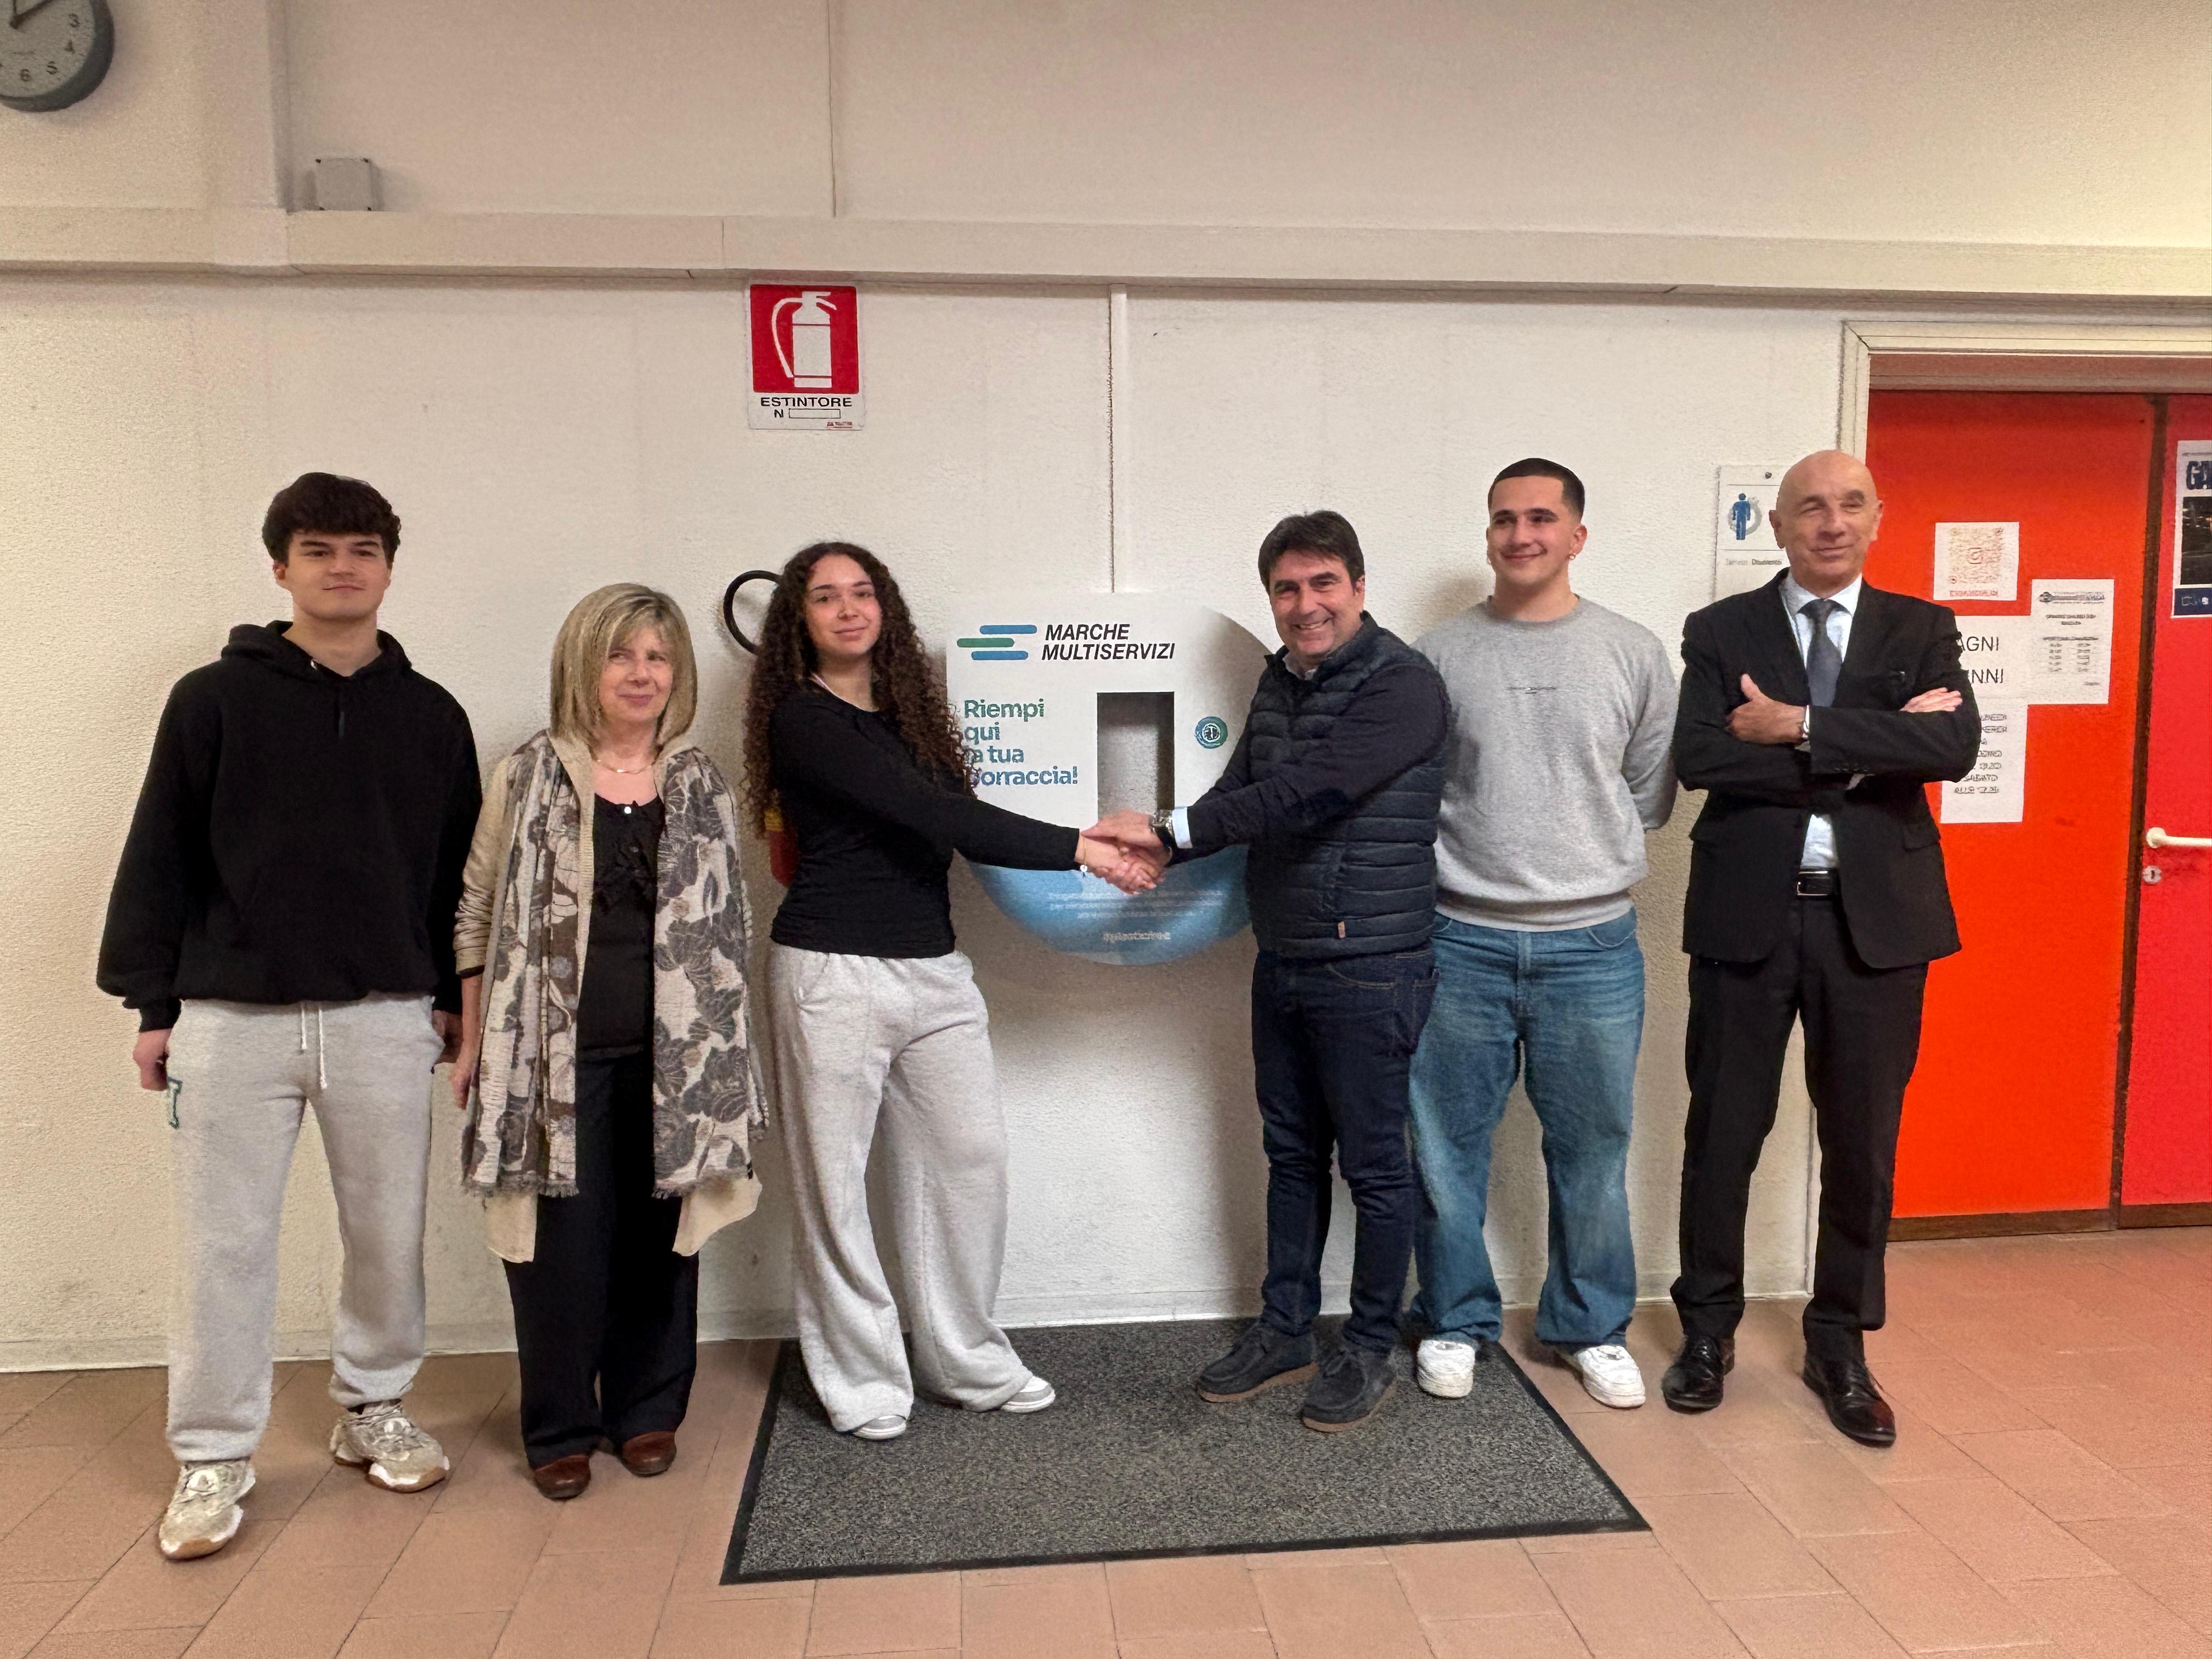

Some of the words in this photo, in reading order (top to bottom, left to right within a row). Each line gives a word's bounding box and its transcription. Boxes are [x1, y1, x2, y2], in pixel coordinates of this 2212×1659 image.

[760, 397, 852, 407] ESTINTORE
[1045, 623, 1131, 641] MARCHE
[1041, 642, 1175, 661] MULTISERVIZI
[964, 698, 1045, 722] Riempi
[964, 721, 1000, 745] qui
[987, 745, 1024, 764] tua
